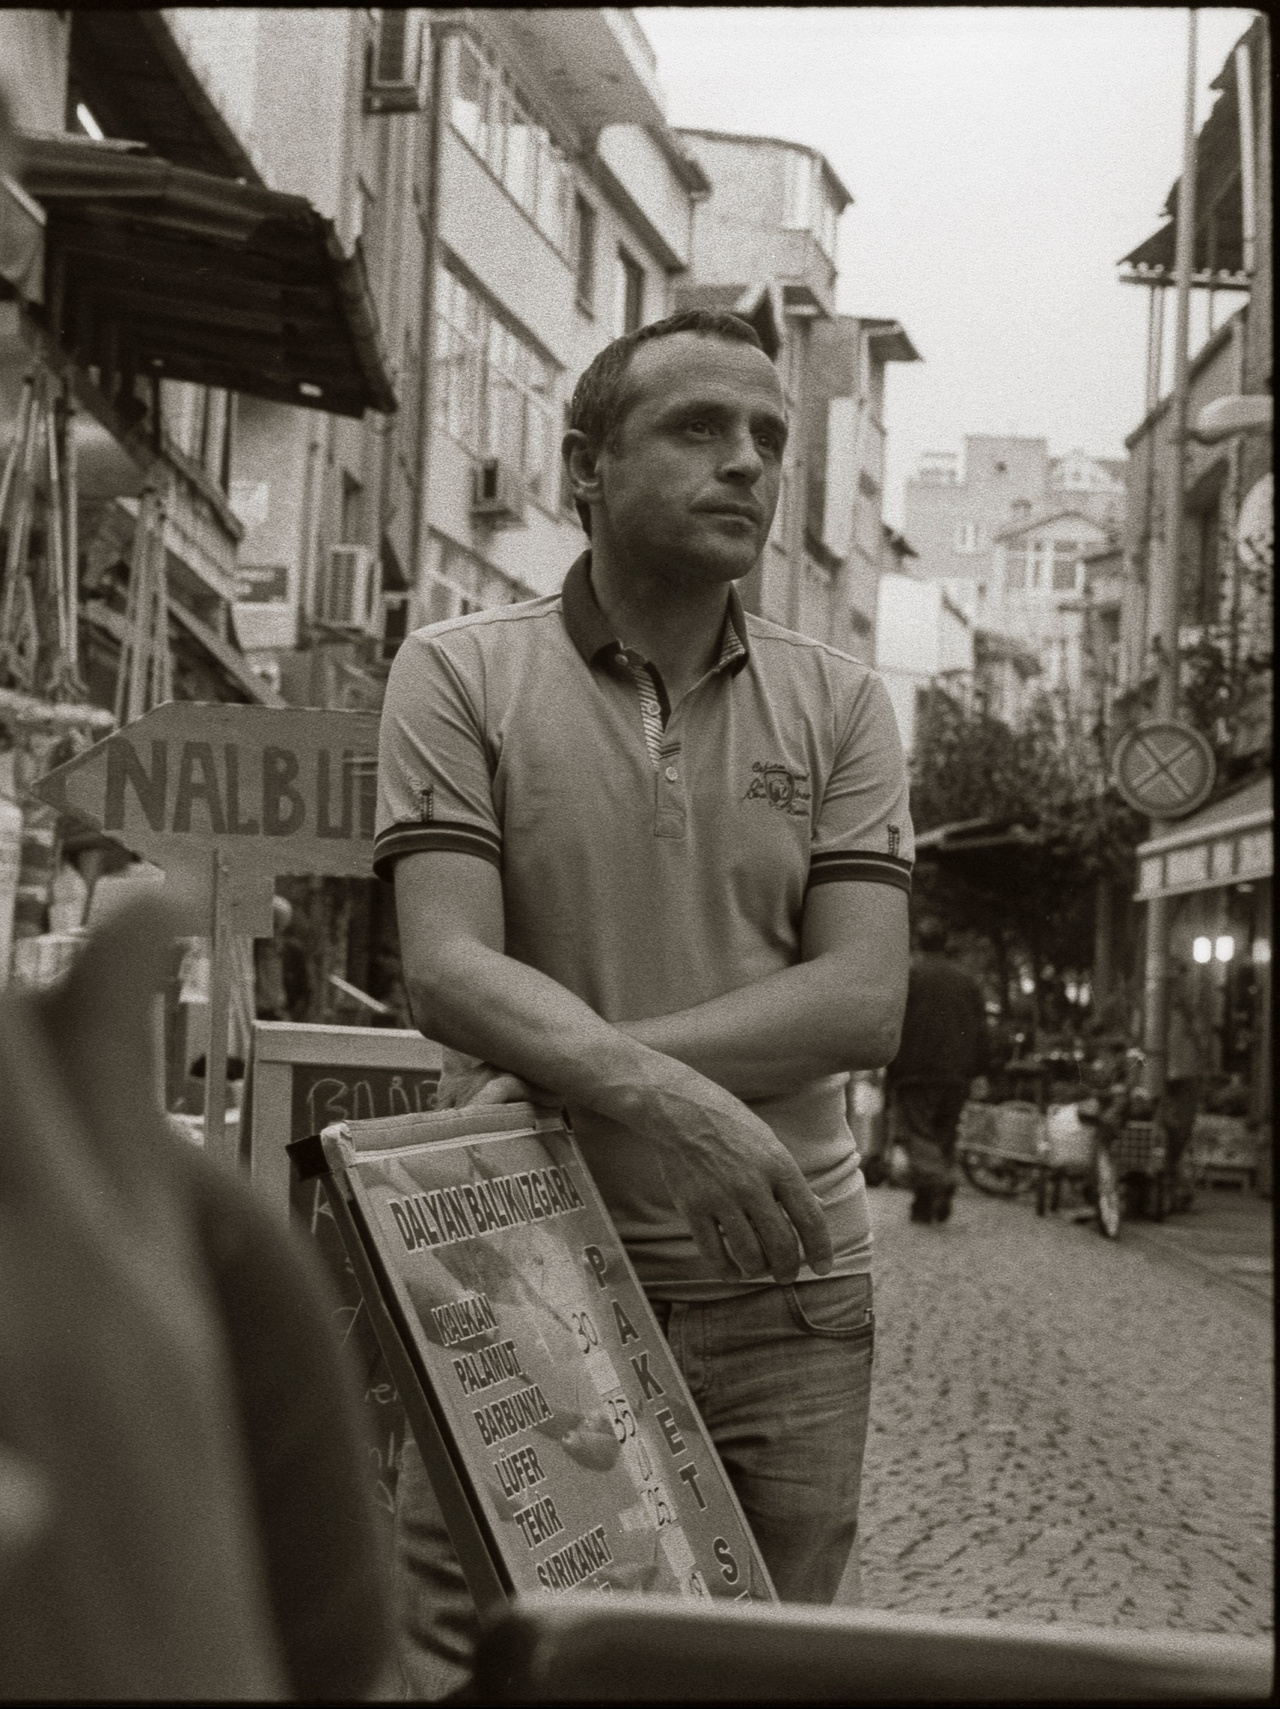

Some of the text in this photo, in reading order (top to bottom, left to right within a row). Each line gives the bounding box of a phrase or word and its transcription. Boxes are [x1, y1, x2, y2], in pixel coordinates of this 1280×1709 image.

[389, 1188, 473, 1251] DALYAN
[461, 1174, 526, 1235] BALIK
[513, 1165, 584, 1221] IZGARA
[431, 1293, 499, 1345] KALKAN
[452, 1339, 523, 1396] PALAMUT
[572, 1311, 598, 1354] 30
[584, 1245, 708, 1511] PAKET
[472, 1384, 554, 1447] BARBUNYA
[493, 1445, 547, 1499] LÜFER
[513, 1491, 565, 1550] TEKİR
[535, 1525, 613, 1594] SARIKANAT
